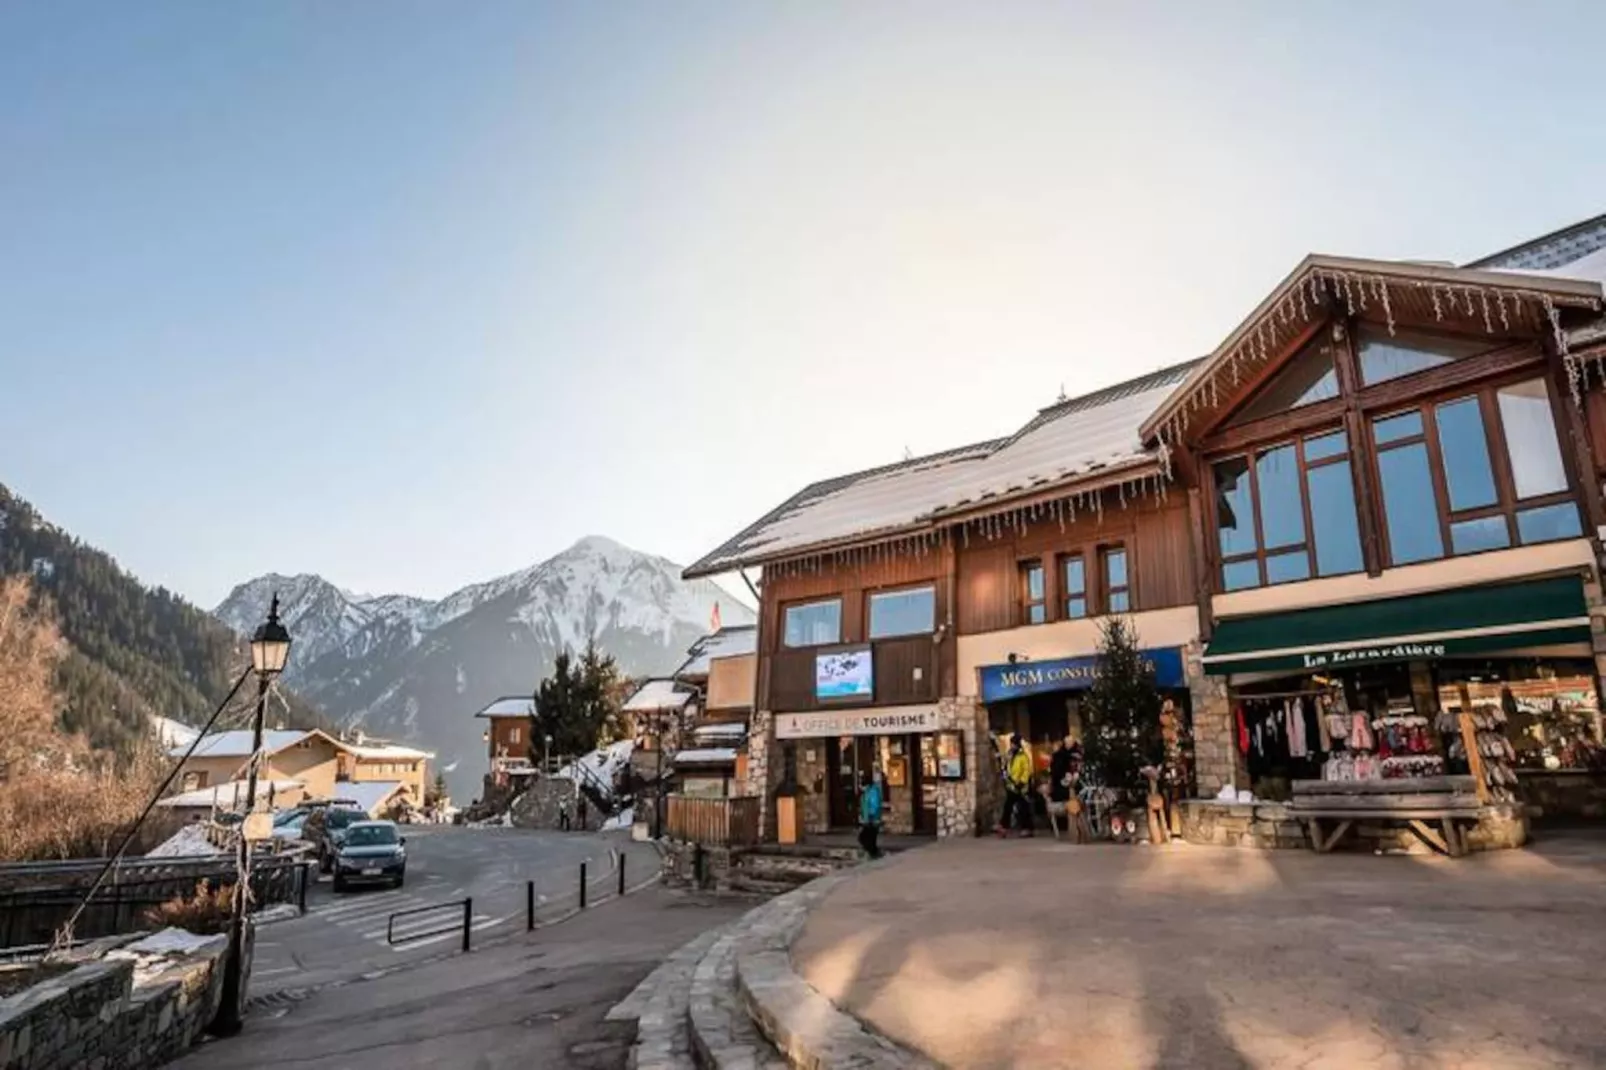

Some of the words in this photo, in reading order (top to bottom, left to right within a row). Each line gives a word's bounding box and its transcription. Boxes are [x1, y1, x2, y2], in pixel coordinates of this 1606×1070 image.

[1303, 654, 1327, 668] La
[1000, 668, 1044, 688] MGM
[803, 716, 839, 731] OFFICE
[845, 716, 861, 729] DE
[863, 713, 926, 728] TOURISME
